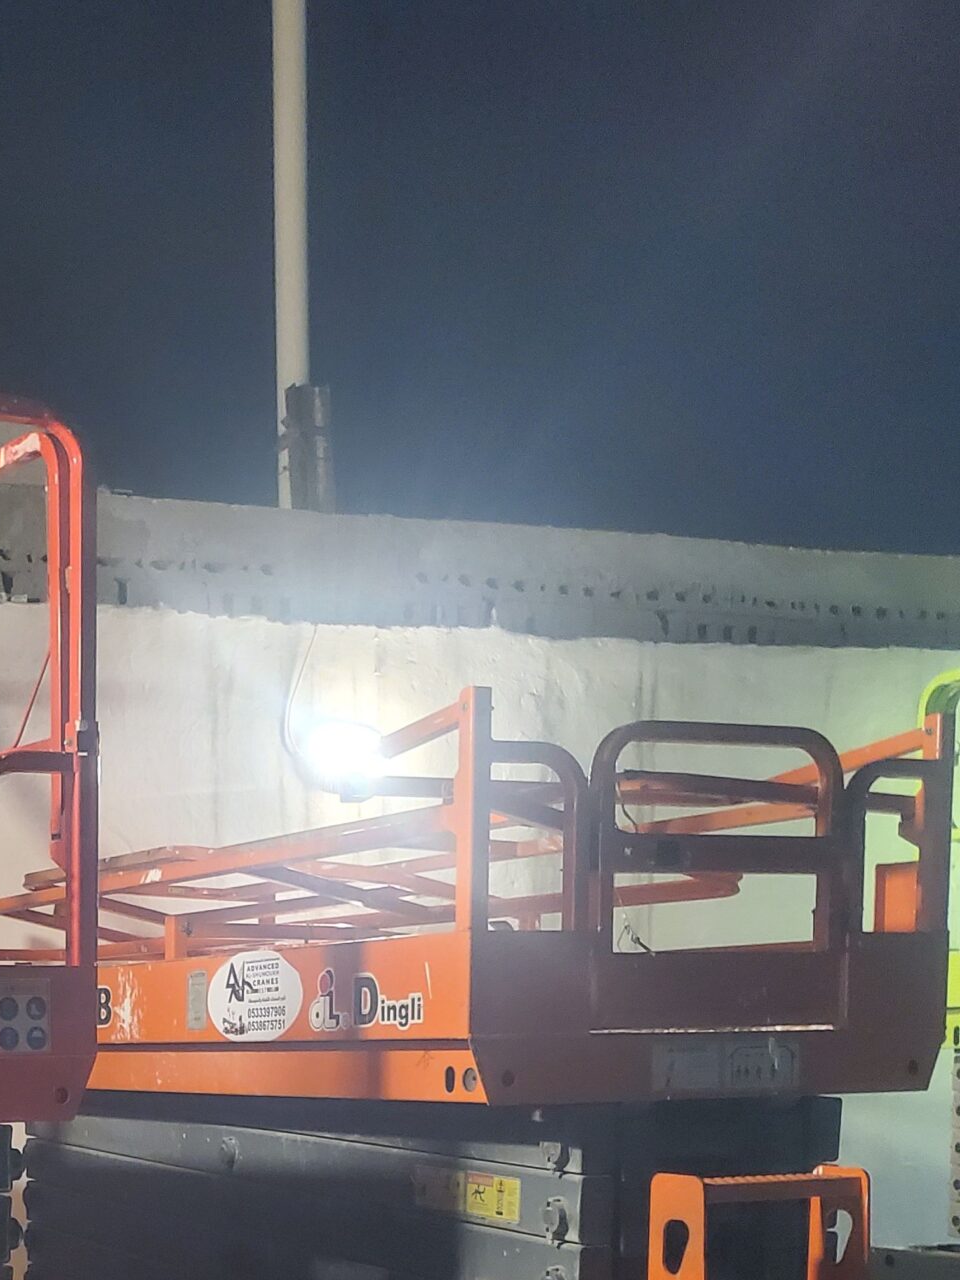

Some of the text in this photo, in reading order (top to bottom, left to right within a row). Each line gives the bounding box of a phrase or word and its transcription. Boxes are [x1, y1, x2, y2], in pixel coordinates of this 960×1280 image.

[247, 962, 279, 971] ADVANCED
[252, 978, 279, 987] CRANES
[354, 976, 422, 1027] Dingli
